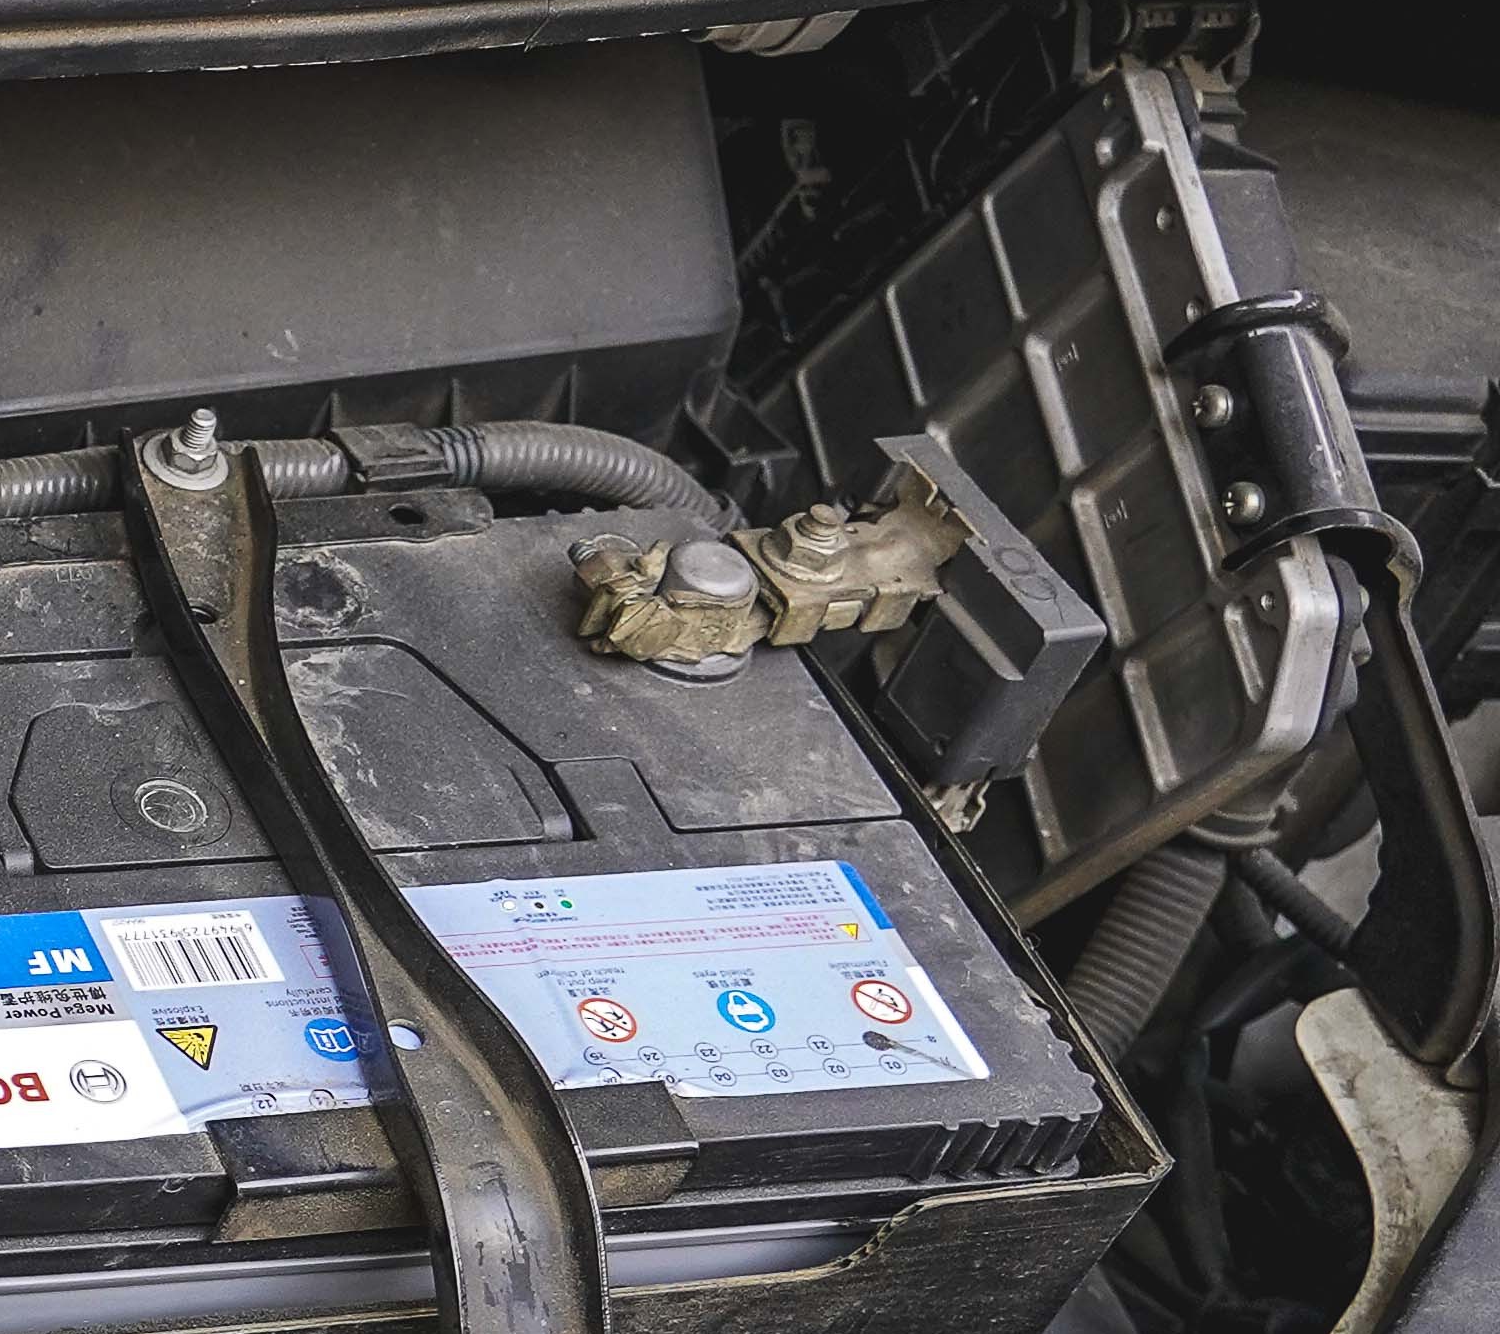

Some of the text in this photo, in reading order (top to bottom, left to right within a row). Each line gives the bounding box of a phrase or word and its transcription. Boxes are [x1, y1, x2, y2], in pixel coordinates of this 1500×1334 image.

[27, 947, 93, 975] MF
[285, 987, 332, 997] carefully
[265, 996, 331, 1008] instructions
[4, 1002, 114, 1020] Mega Power
[151, 1005, 203, 1015] Explosive
[756, 1044, 772, 1054] 22
[812, 1040, 829, 1050] 21
[643, 1052, 660, 1061] 24
[700, 1048, 716, 1057] 23
[829, 1065, 845, 1074] 02
[886, 1061, 901, 1070] 01
[714, 1072, 731, 1081] 04
[771, 1068, 788, 1078] 03
[256, 1099, 273, 1109] 12
